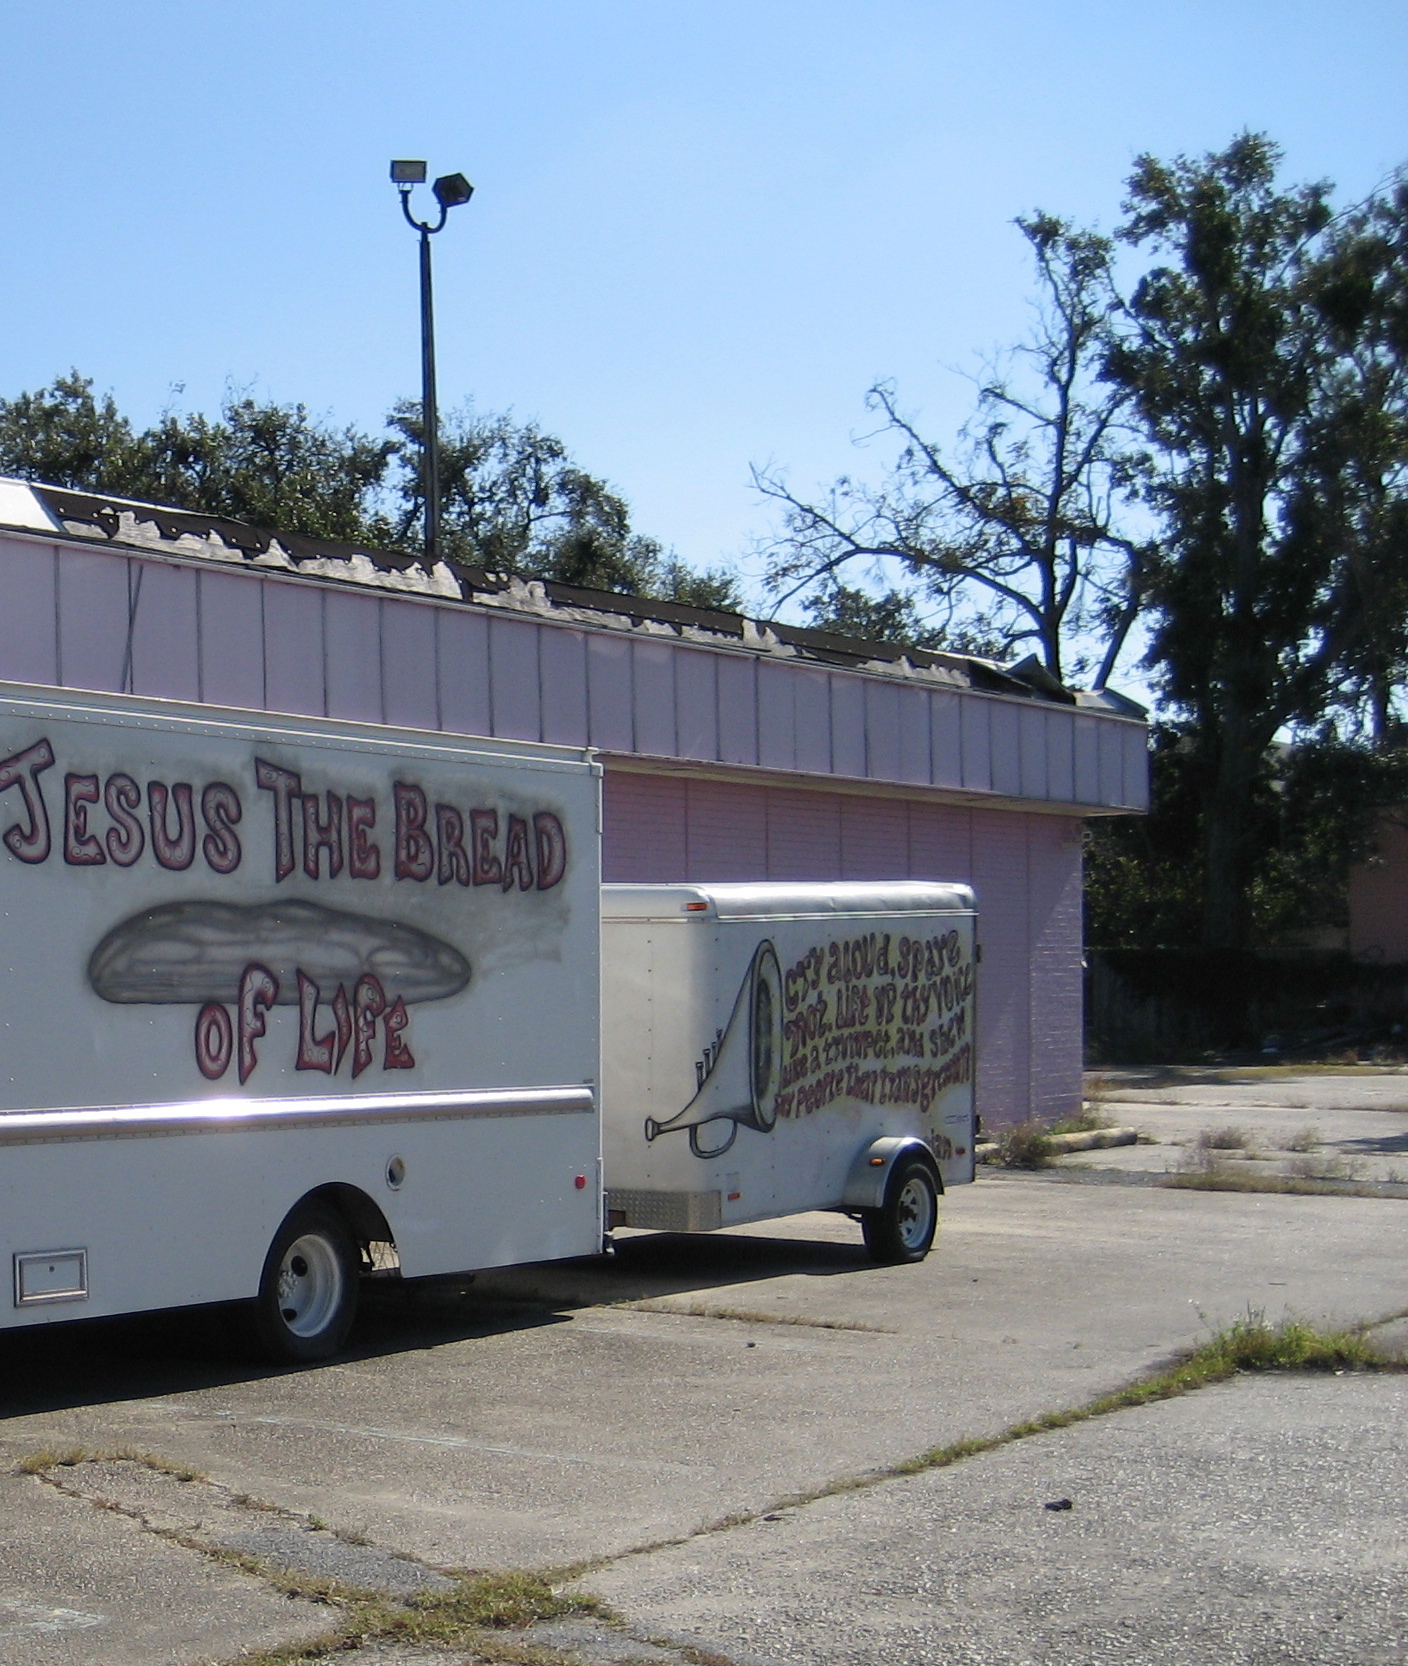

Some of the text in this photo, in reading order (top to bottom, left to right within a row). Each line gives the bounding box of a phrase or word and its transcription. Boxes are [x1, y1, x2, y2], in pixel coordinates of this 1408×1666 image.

[255, 756, 380, 883] THE
[393, 781, 568, 892] BREAD
[195, 963, 416, 1085] OF LIFE
